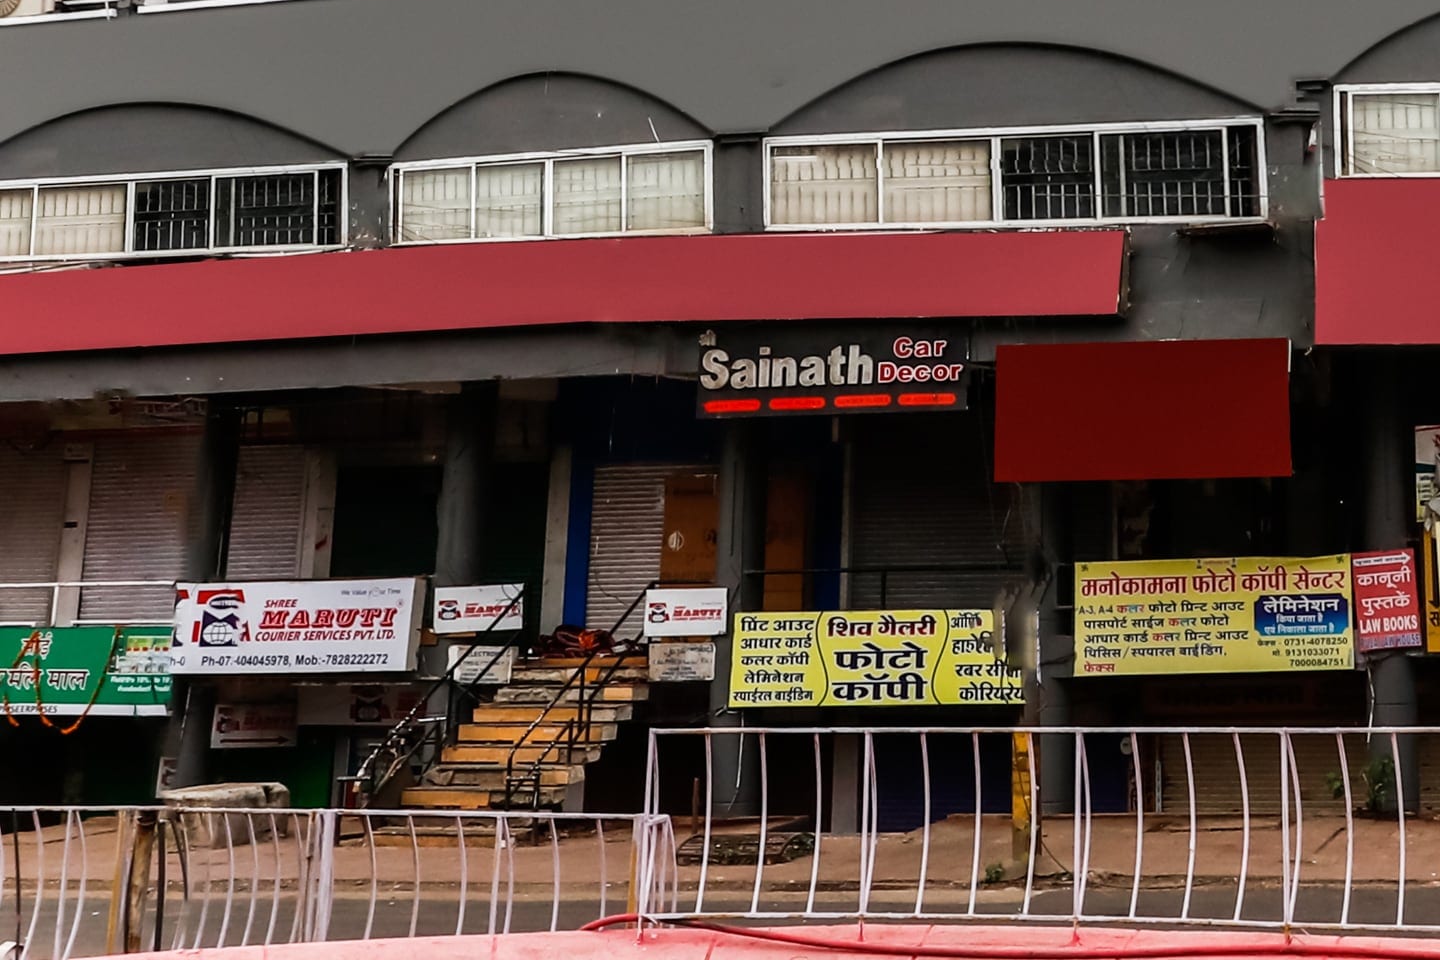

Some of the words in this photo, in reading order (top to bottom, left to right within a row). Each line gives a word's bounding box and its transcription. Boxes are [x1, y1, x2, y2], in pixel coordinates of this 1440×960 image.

[893, 336, 947, 358] Car
[700, 345, 873, 389] Sainath
[878, 362, 963, 383] Decor
[1081, 572, 1187, 597] मनोकामना
[1193, 568, 1236, 593] फोटो
[1241, 565, 1287, 592] कॉपी
[1293, 565, 1346, 590] सेन्टर
[1356, 565, 1411, 588] कानूनी
[264, 599, 298, 608] SHREE
[1116, 603, 1145, 614] कलर
[1149, 600, 1177, 613] फोटो
[1211, 601, 1245, 611] आउट
[1263, 596, 1339, 613] लेमिनेशन
[257, 607, 398, 629] MARUTI
[773, 619, 814, 631] आउट
[828, 616, 872, 637] शिव
[878, 615, 937, 637] गैलरी
[1084, 616, 1127, 629] पासपोर्ट
[1131, 617, 1165, 629] साईज
[1168, 617, 1197, 627] कलर
[1200, 614, 1229, 626] फोटो
[1360, 618, 1381, 634] LAW
[1383, 614, 1418, 632] BOOKS
[255, 631, 301, 641] COURIER
[304, 630, 352, 641] SERVICES
[376, 629, 396, 639] LTD.
[741, 637, 781, 649] आधार
[785, 633, 812, 649] कार्ड
[1084, 632, 1119, 644] आधार
[1123, 630, 1149, 642] कार्ड
[1152, 632, 1181, 642] कलर
[1215, 630, 1249, 640] आउट
[1284, 637, 1348, 646] 0731-4078250
[741, 655, 772, 666] कलर
[776, 651, 809, 665] कॉपी
[834, 641, 928, 669] फोटो
[1285, 648, 1340, 656] 9131033071
[1290, 658, 1344, 667] 7000084751
[47, 669, 90, 690] माल
[744, 669, 804, 683] लेमिनेशन
[832, 672, 928, 701] कॉपी
